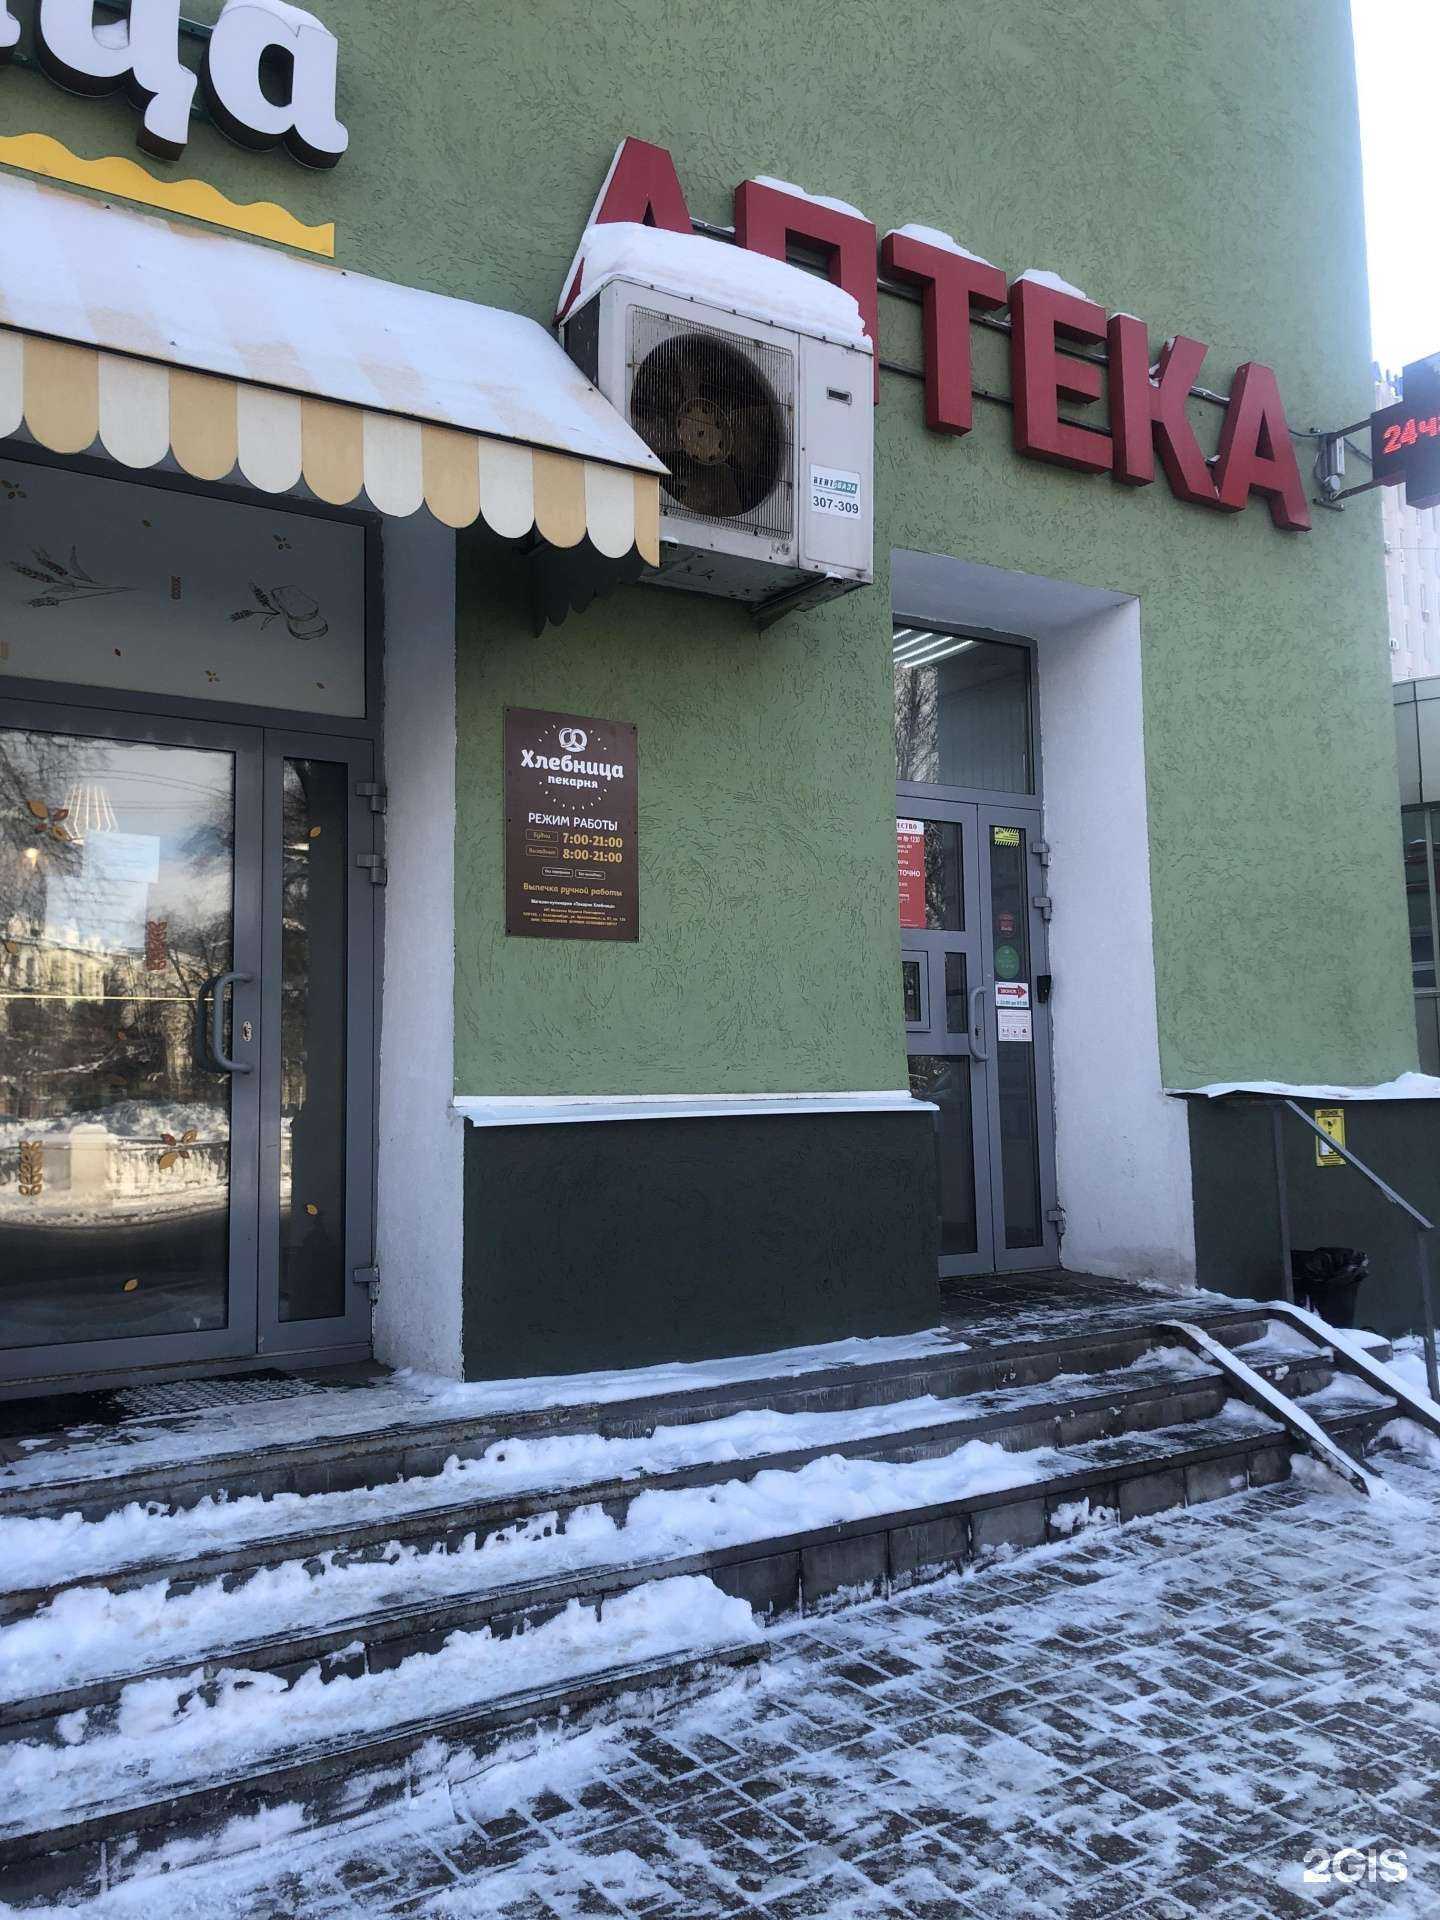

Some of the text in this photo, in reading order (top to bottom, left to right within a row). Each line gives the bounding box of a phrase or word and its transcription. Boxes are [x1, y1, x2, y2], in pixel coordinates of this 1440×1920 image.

[0, 0, 348, 160] ца
[812, 495, 859, 515] 307-309
[521, 748, 624, 780] Хлебница
[547, 775, 599, 789] пекарня
[528, 812, 618, 831] РЕЖИМ РАБОТЫ
[562, 832, 623, 848] 7:00-21:00
[562, 848, 623, 863] 8:00-21:00
[523, 882, 623, 897] Выпечка ручной работы
